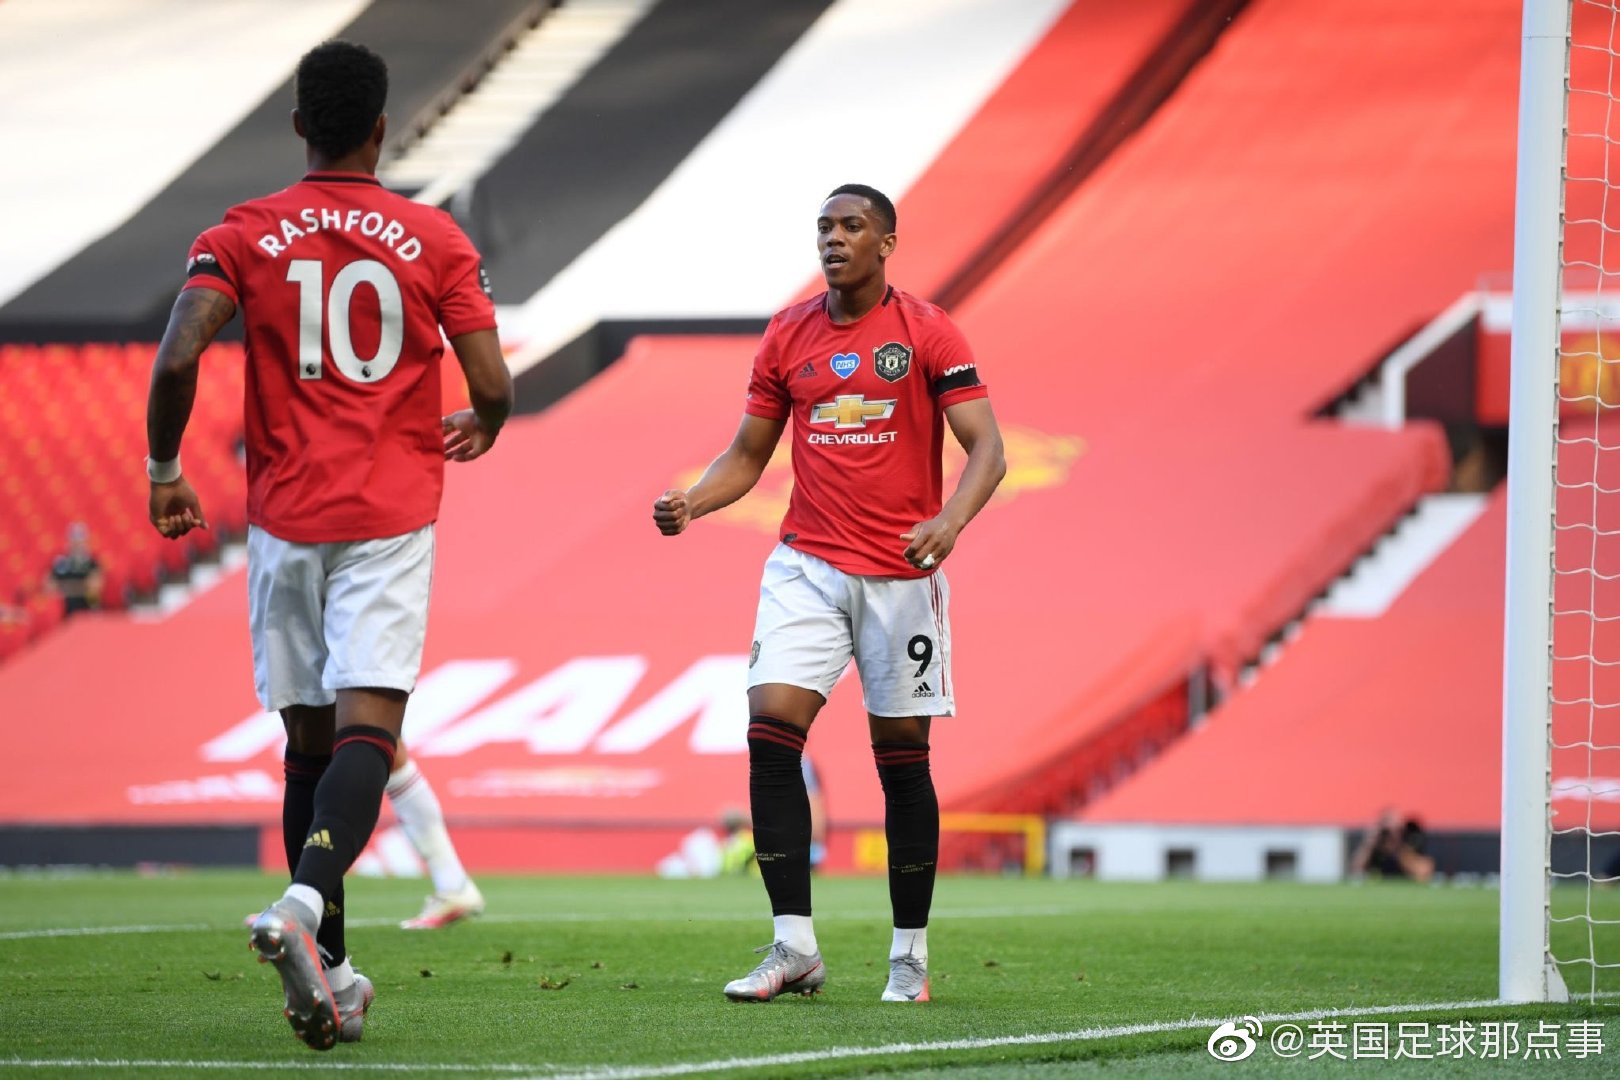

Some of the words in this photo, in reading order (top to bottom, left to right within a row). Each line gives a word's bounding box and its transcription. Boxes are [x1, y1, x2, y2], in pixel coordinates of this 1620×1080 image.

[257, 207, 422, 262] RASHFORD
[286, 259, 404, 383] 10
[836, 361, 854, 369] NHS
[807, 431, 898, 445] CHEVROLET
[907, 634, 933, 678] 9
